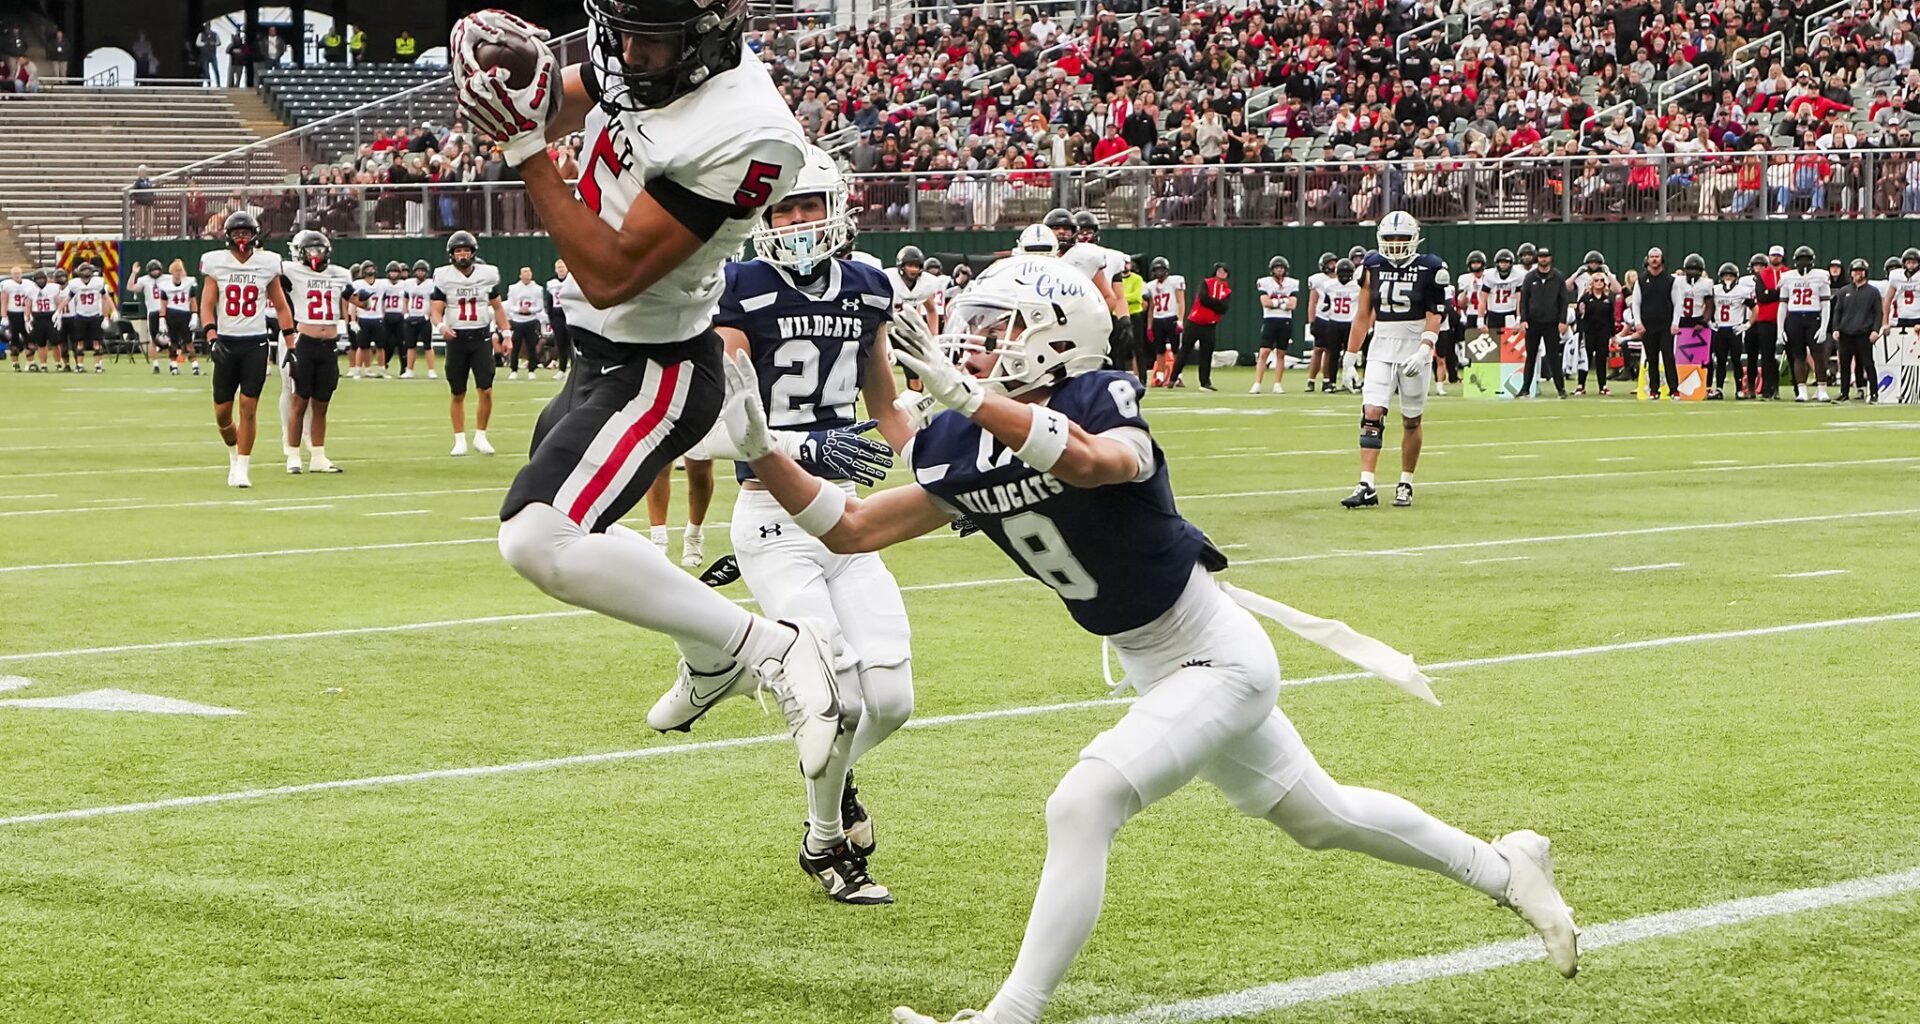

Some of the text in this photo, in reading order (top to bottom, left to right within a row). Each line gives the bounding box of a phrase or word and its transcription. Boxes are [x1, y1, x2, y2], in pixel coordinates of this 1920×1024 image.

[733, 159, 781, 208] 5
[229, 274, 257, 285] ARGYLE
[1378, 272, 1418, 282] WILDATS
[225, 284, 259, 317] 88
[306, 289, 334, 320] 21
[458, 298, 478, 321] 11
[1378, 281, 1414, 313] 15
[1494, 289, 1512, 304] 17
[1683, 298, 1694, 317] 9
[1792, 288, 1813, 305] 32
[777, 314, 862, 339] WILDCATS
[1720, 304, 1731, 322] 6
[768, 339, 860, 427] 24
[1107, 379, 1139, 419] 8
[954, 472, 1064, 514] WILDCATS
[1001, 510, 1099, 601] 8
